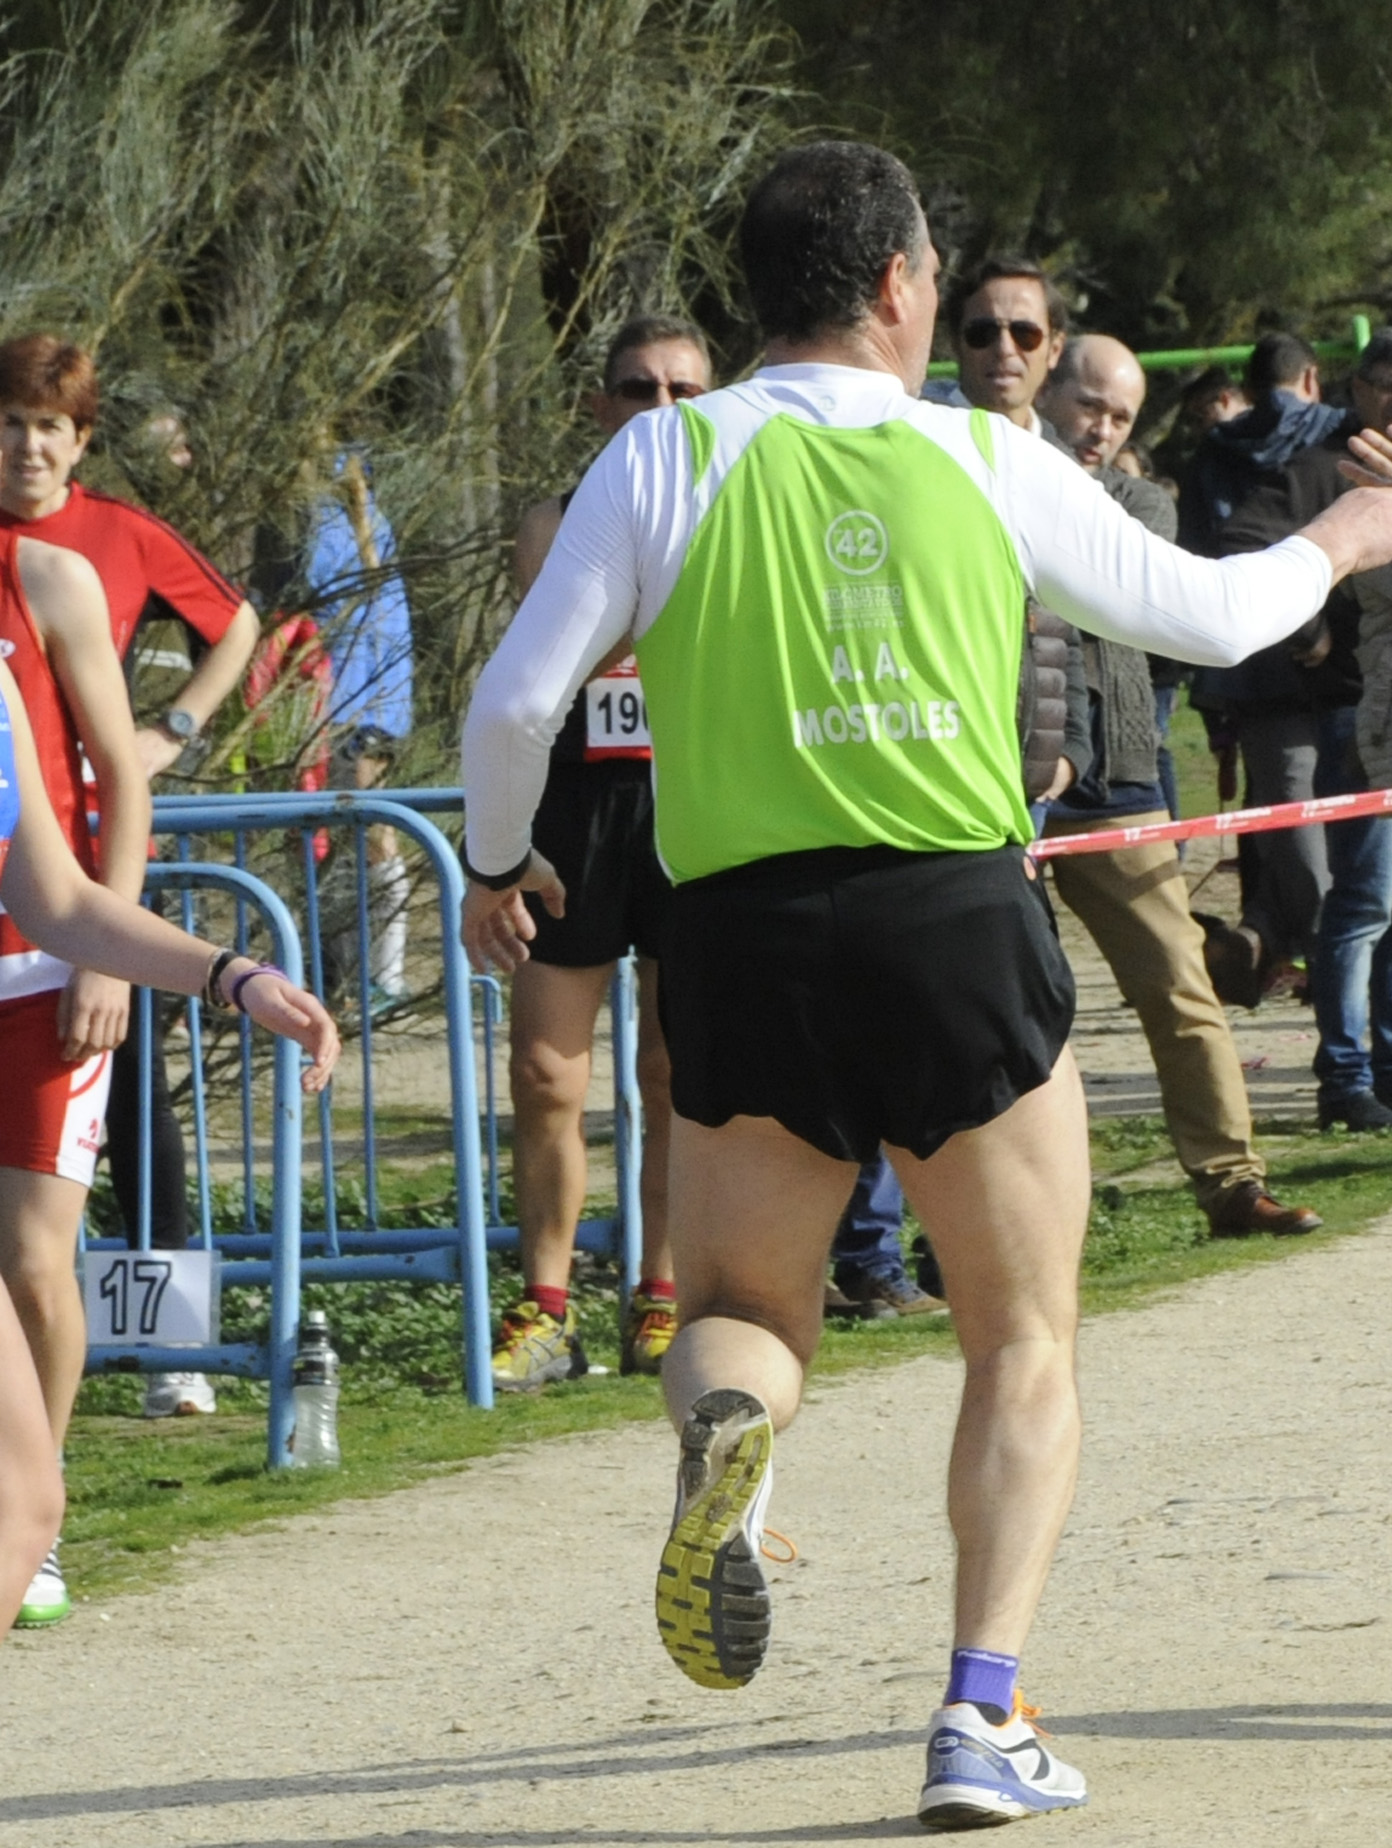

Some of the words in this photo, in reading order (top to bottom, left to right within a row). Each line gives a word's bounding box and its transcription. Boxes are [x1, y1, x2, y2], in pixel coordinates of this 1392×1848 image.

[834, 528, 879, 557] 42
[793, 700, 961, 748] MOSTOLES
[100, 1259, 173, 1336] 17
